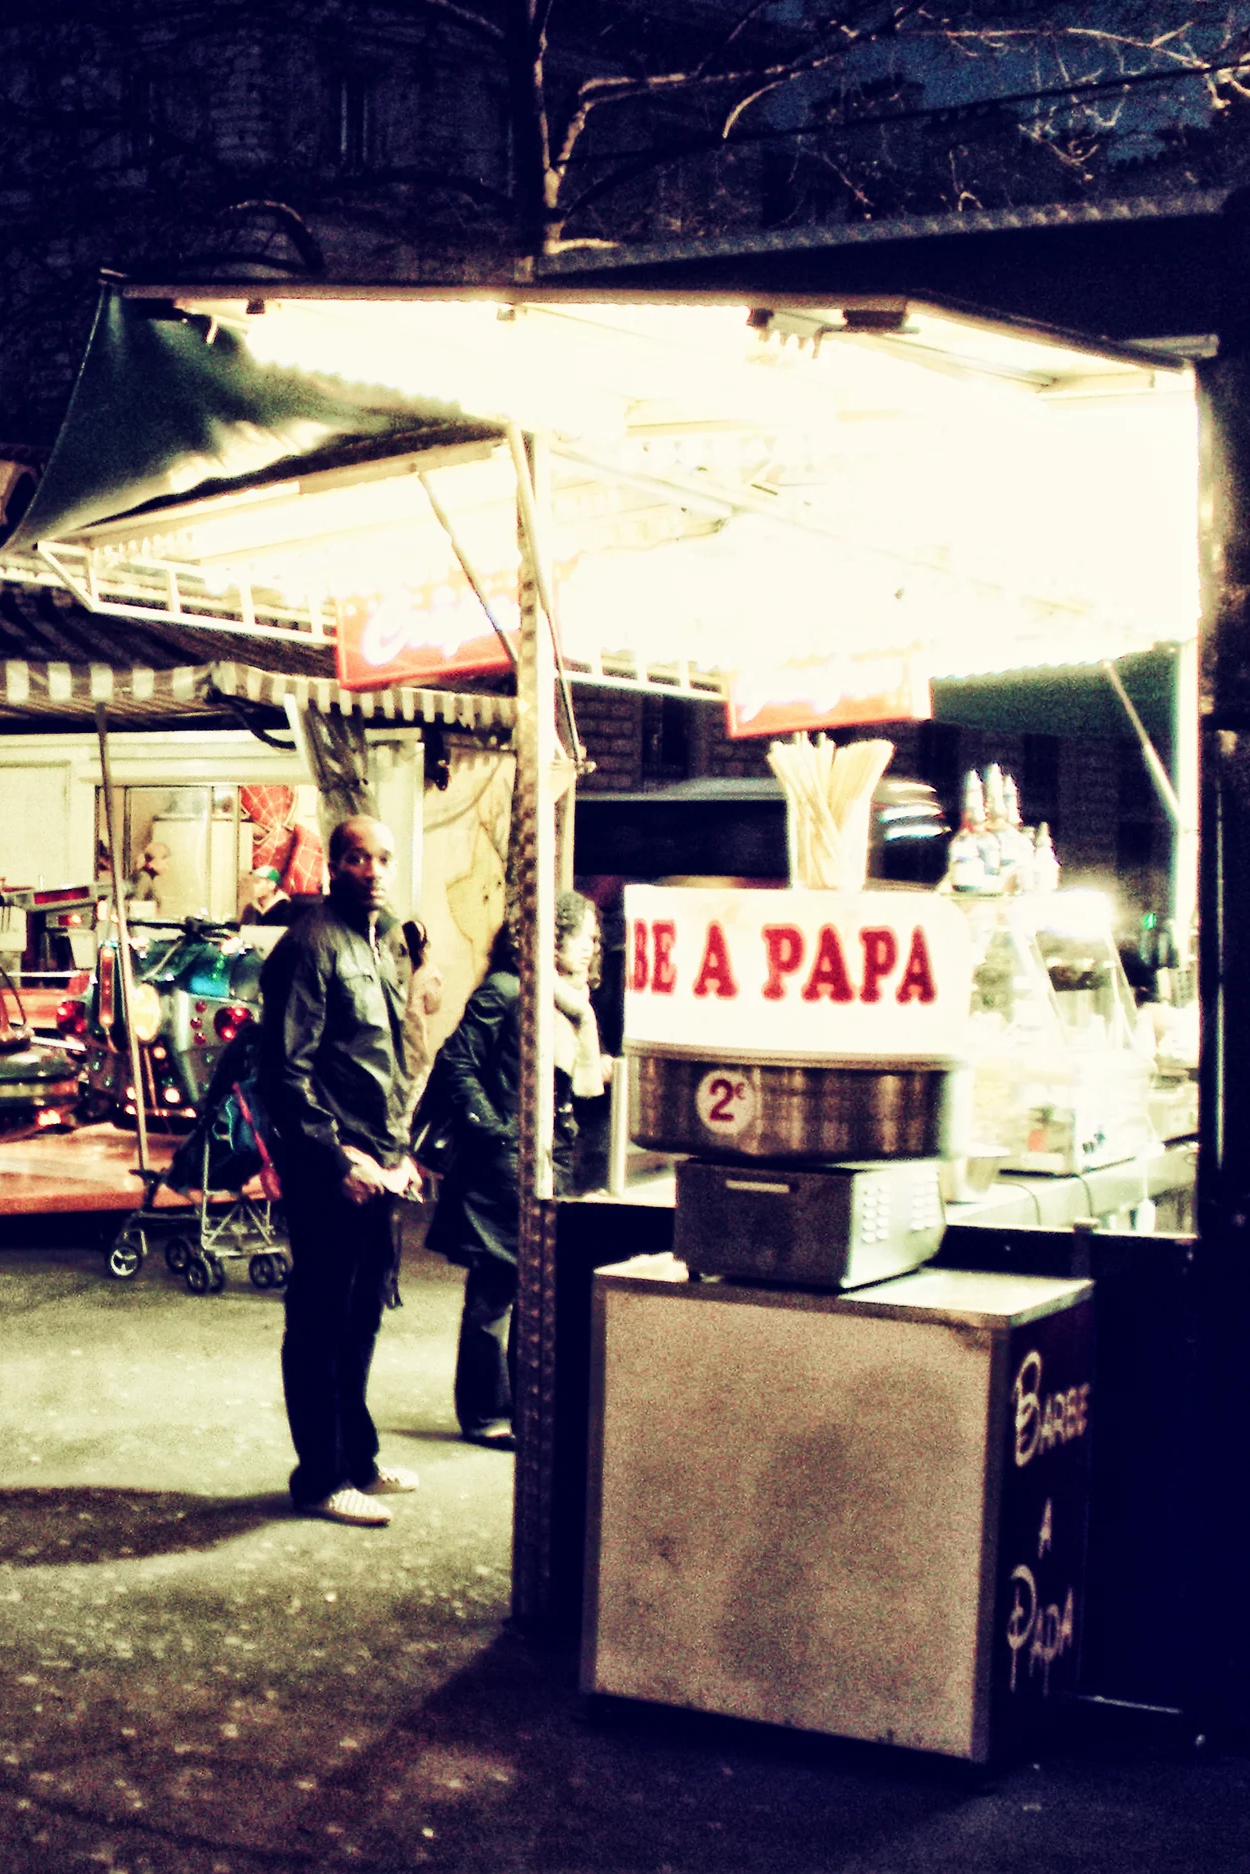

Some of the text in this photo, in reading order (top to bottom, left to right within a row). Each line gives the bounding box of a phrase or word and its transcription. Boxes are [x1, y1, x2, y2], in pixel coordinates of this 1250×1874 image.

[693, 920, 738, 999] A
[762, 923, 937, 1005] PAPA
[709, 1078, 746, 1121] 2€
[1038, 1497, 1052, 1559] A
[1007, 1564, 1074, 1696] PAPA
